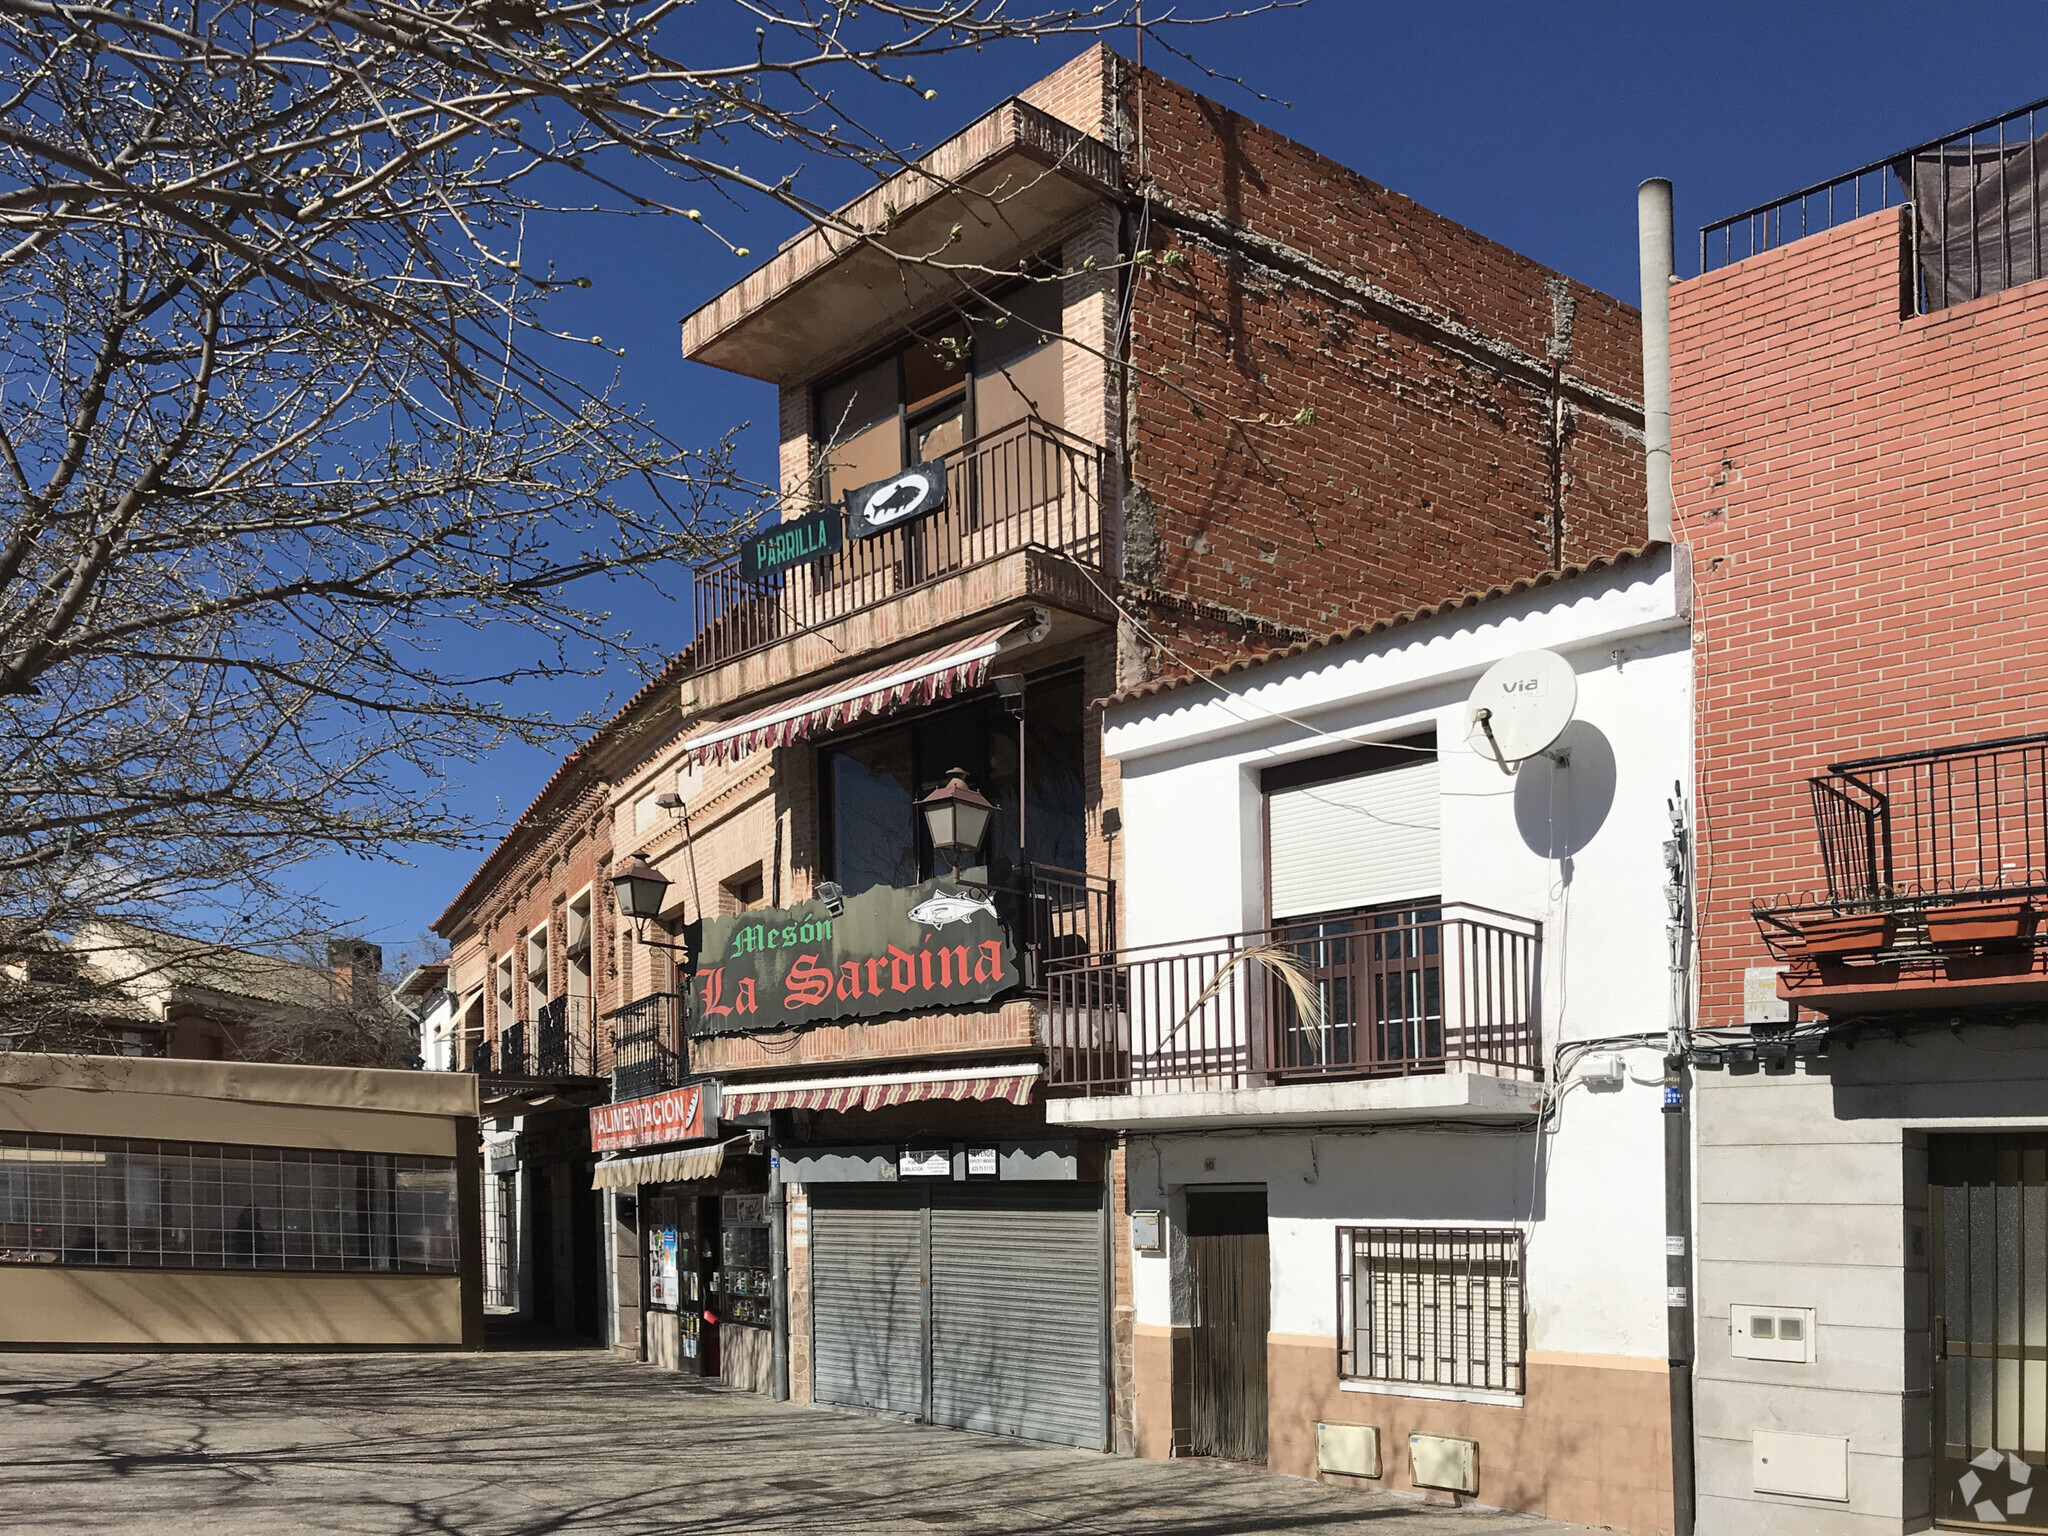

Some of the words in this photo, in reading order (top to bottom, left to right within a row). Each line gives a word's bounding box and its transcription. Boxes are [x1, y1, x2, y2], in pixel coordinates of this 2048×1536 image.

[757, 520, 827, 570] PARRILLA
[730, 914, 833, 959] Mesón
[696, 965, 759, 1018] La
[784, 934, 1005, 1010] Sardina
[597, 1092, 685, 1134] ALIMENTACIÓN
[977, 1148, 994, 1158] VENDE
